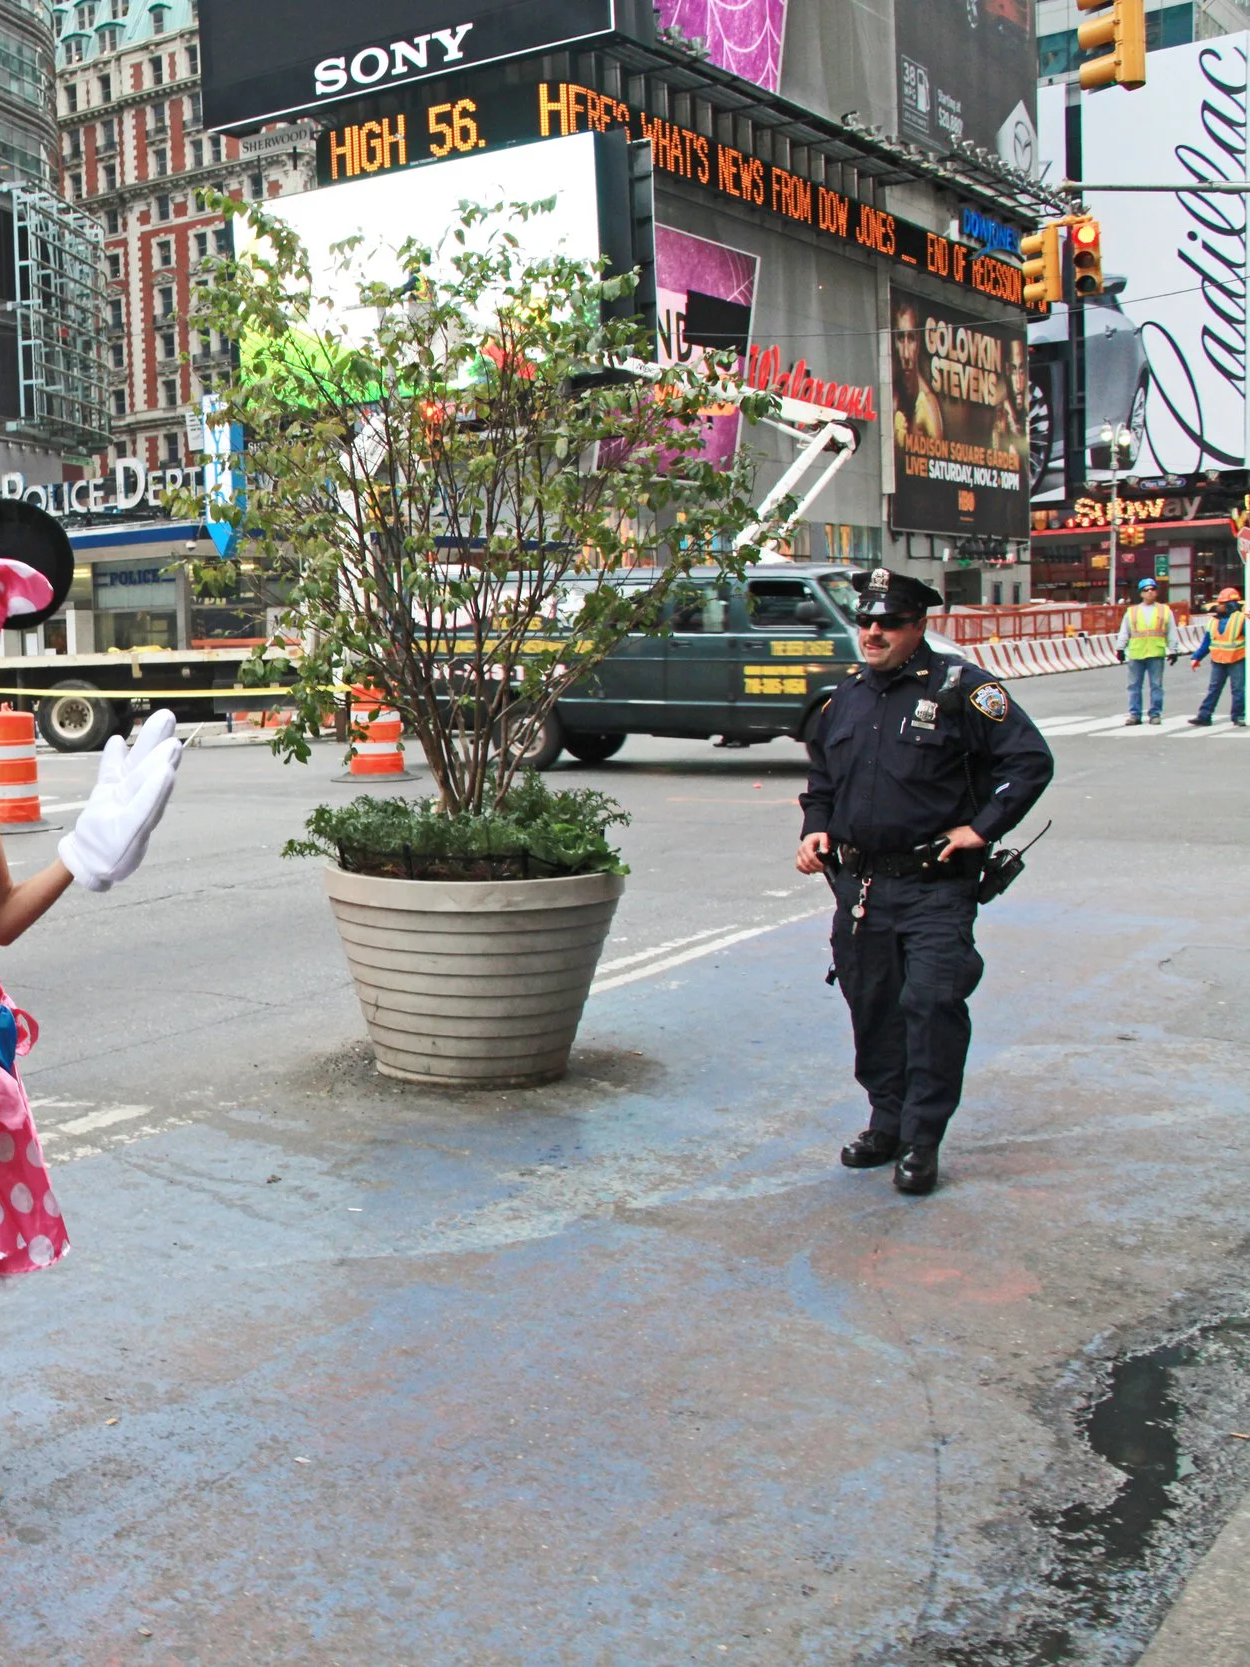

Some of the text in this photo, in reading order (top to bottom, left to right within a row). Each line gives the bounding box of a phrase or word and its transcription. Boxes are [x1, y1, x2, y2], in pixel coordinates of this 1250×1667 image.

[314, 22, 473, 96] SONY
[242, 129, 307, 153] SHERWOOD
[330, 98, 486, 180] HIGH 56.
[641, 111, 710, 184] WHAT'S
[718, 144, 764, 206] NEWS
[772, 166, 812, 224] FROM
[818, 186, 849, 238] DOW
[856, 203, 896, 255] JONES
[927, 232, 948, 276] END
[954, 244, 967, 283] OF
[972, 256, 1022, 304] RECESSION
[925, 317, 1002, 373] GOLOVKIN
[931, 356, 998, 407] STEVENS
[905, 434, 1020, 471] MADISON SQUARE GARDEN
[928, 460, 973, 487] SATURDAY,
[991, 469, 998, 488] 2
[1000, 471, 1019, 491] 10PM
[1, 471, 105, 516] POLICE
[116, 457, 202, 510] DEPT
[110, 568, 160, 586] POLICE
